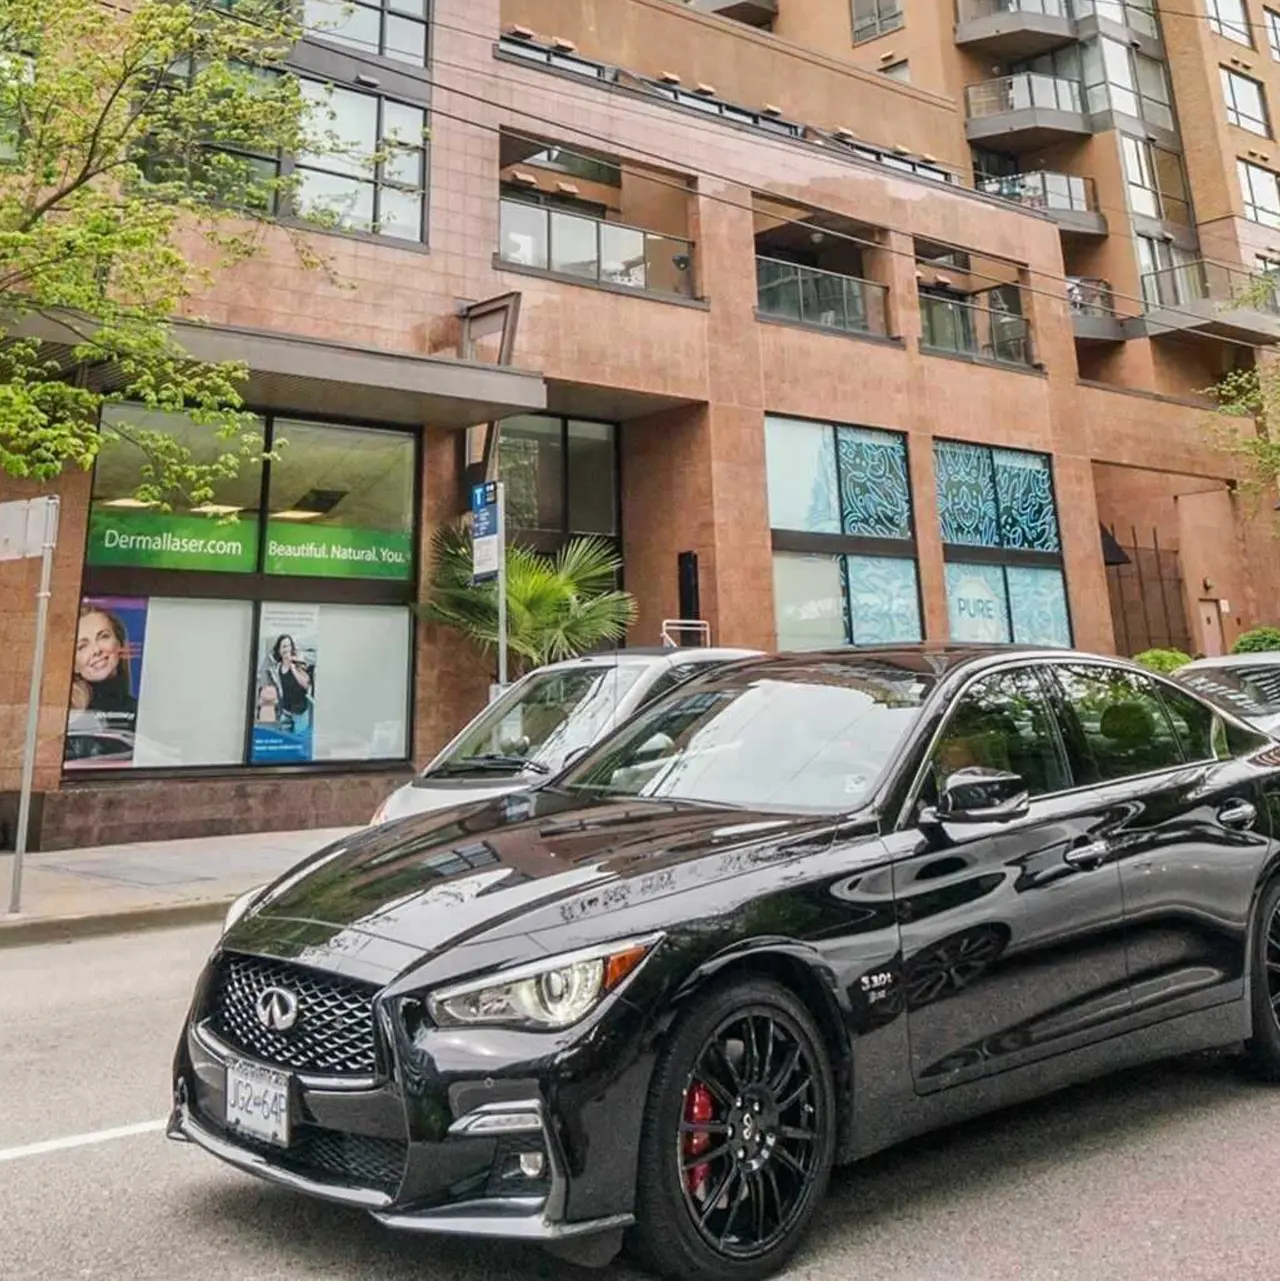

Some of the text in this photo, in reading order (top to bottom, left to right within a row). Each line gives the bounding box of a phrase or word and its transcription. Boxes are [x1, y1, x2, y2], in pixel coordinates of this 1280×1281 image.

[103, 529, 243, 557] Dermallaser.com
[268, 540, 406, 564] Beautiful. Natural. You.
[958, 598, 995, 619] PURE
